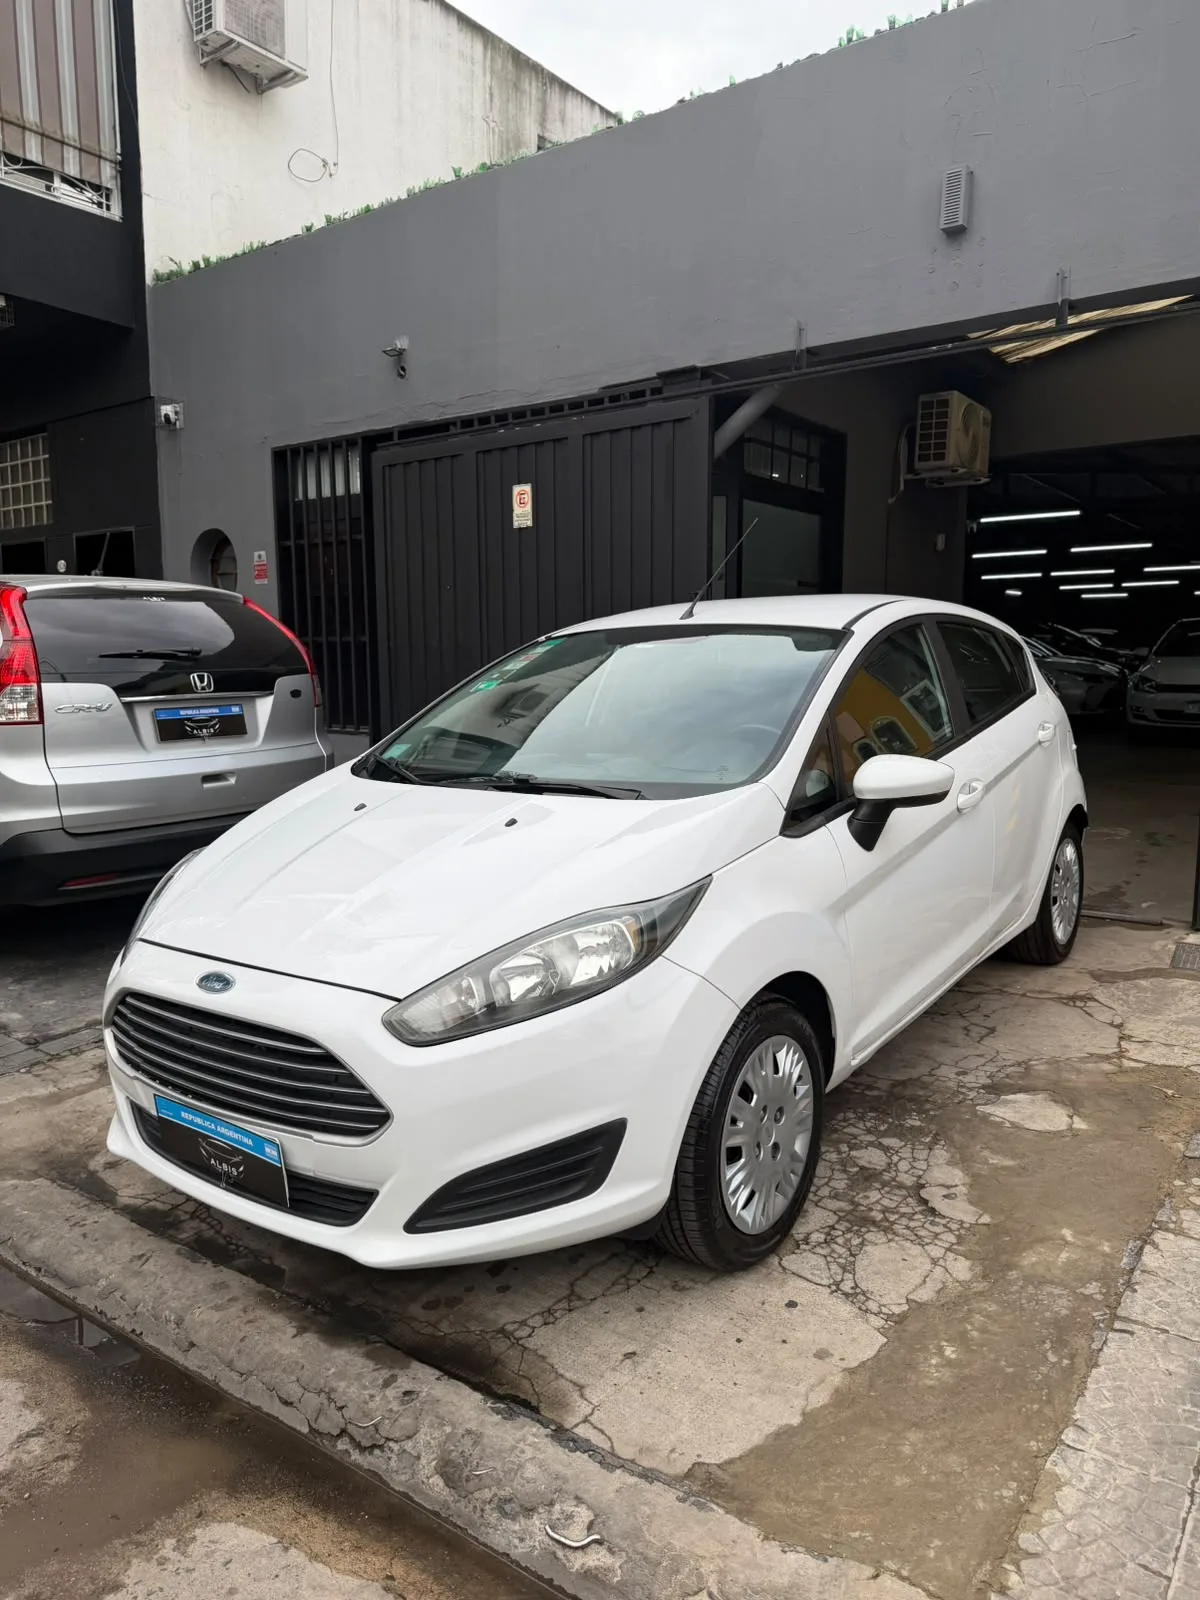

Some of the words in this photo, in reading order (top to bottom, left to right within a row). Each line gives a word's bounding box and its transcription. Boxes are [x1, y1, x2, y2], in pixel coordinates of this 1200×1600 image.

[54, 702, 114, 715] CR-V
[193, 727, 215, 735] ALBIS
[201, 975, 228, 989] Ford
[180, 1110, 217, 1131] REPUBLICA
[216, 1124, 254, 1147] ARGENTINA
[210, 1157, 238, 1176] ALBIS
